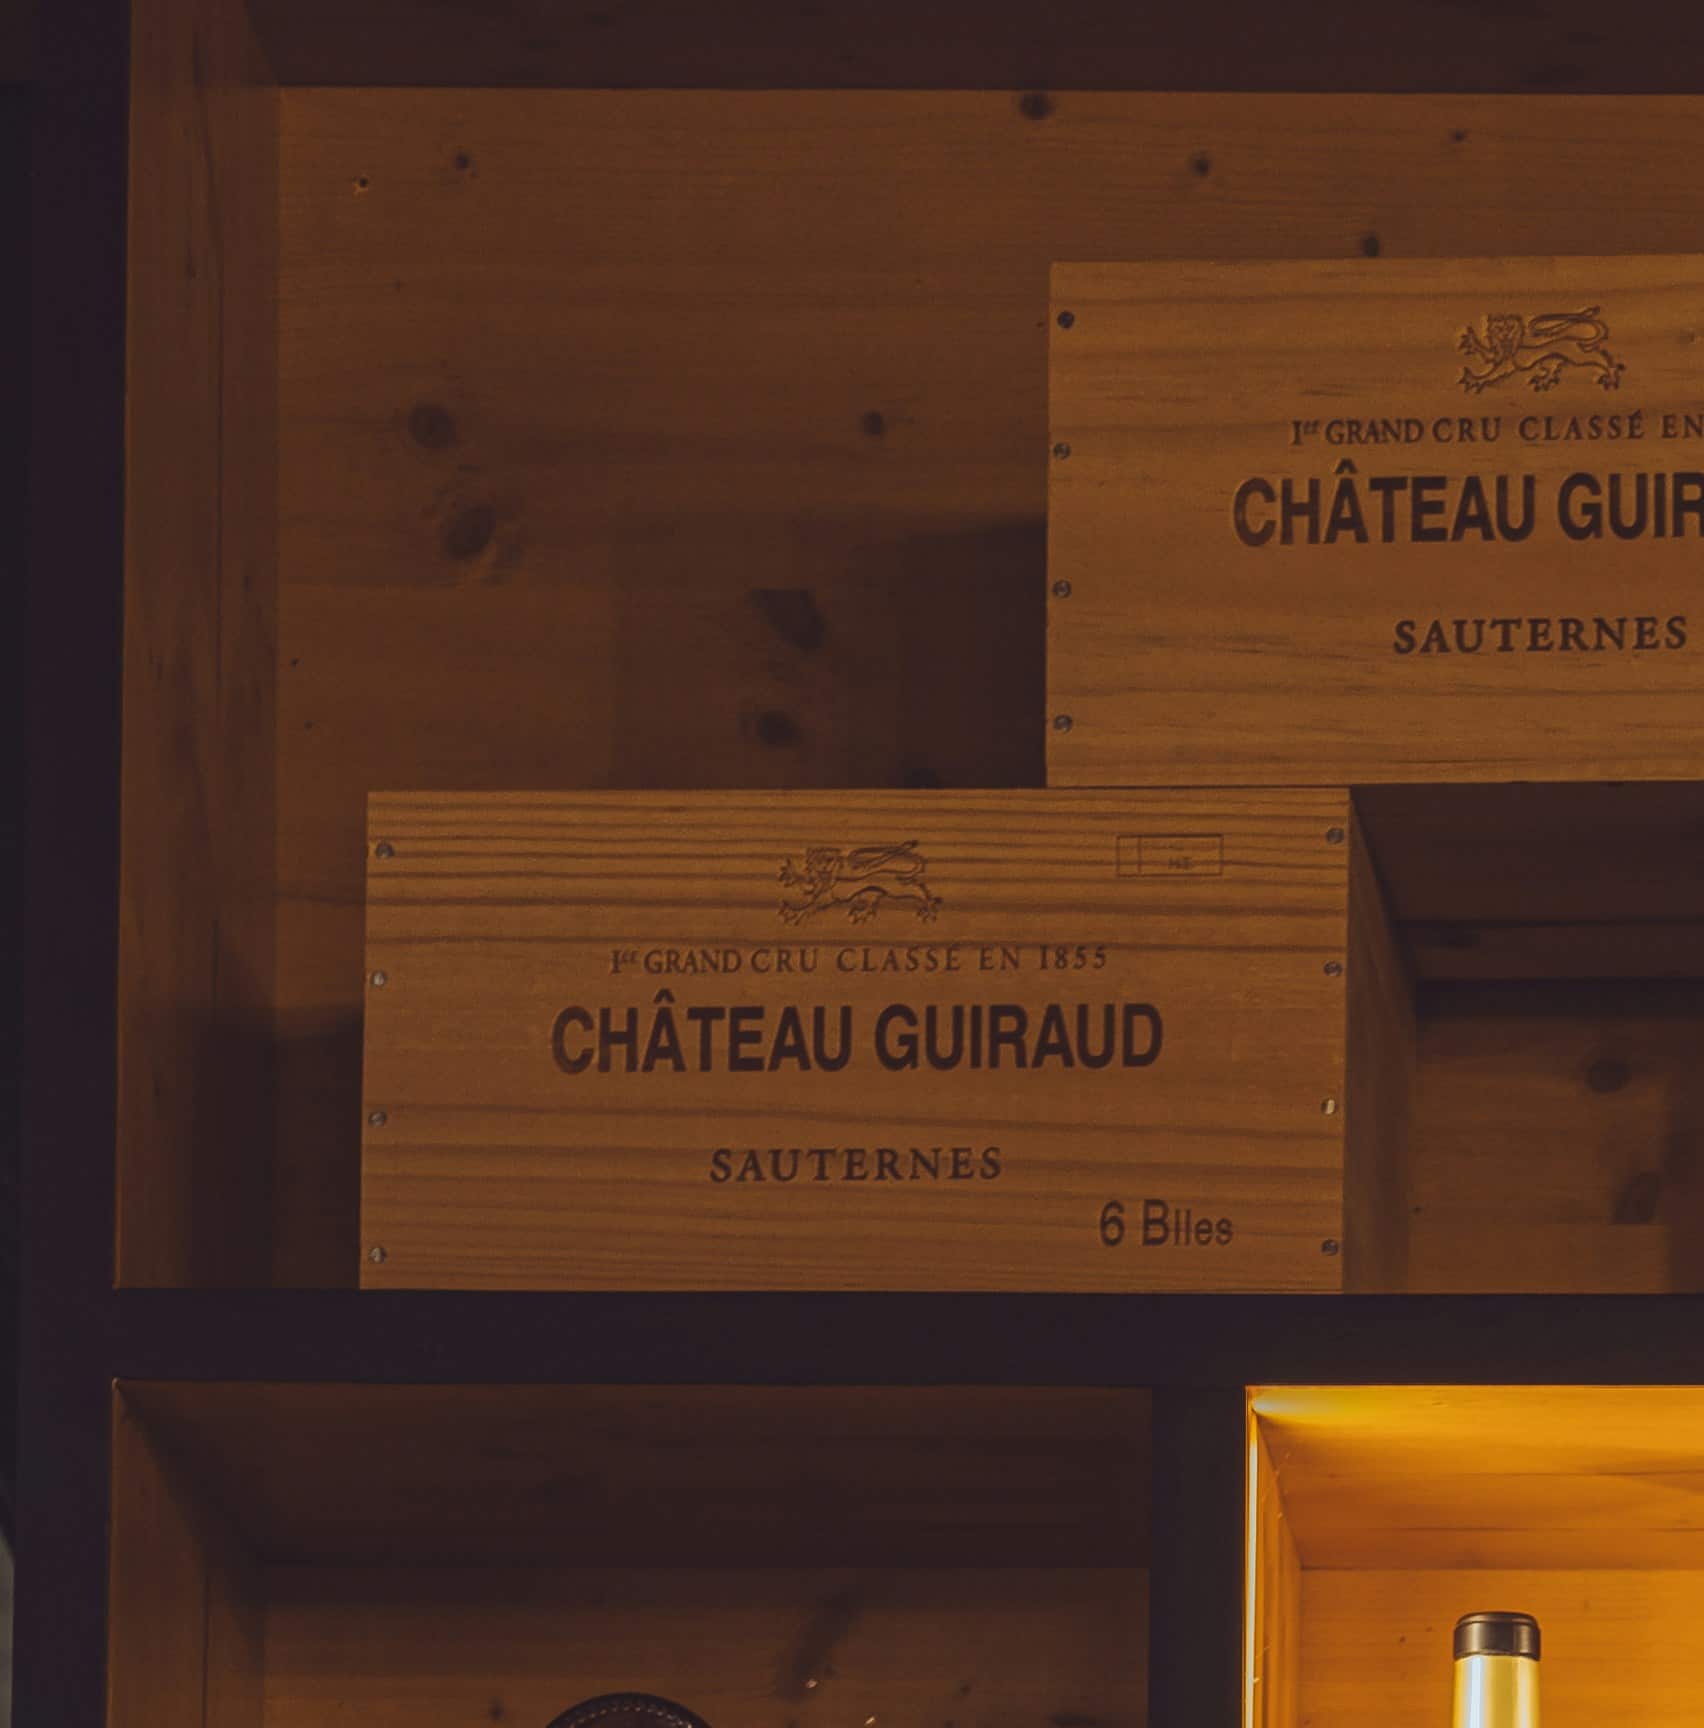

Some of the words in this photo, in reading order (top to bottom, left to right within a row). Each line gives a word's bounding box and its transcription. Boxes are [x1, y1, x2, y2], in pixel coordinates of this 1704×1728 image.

[1325, 418, 1424, 445] GRAND
[1432, 416, 1503, 443] CRU
[1518, 408, 1645, 441] CLASSÉ
[1661, 414, 1704, 439] EN
[1234, 458, 1536, 547] CHÂTEAU
[1393, 615, 1687, 655] SAUTERNES
[643, 948, 742, 974] GRAND
[751, 948, 818, 973] CRU
[835, 943, 961, 972] CLASSÉ
[978, 946, 1020, 971] EN
[1039, 945, 1107, 971] 1855
[552, 988, 852, 1074] CHÂTEAU
[875, 1002, 1163, 1072] GUIRAUD
[710, 1147, 1001, 1183] SAUTERNES
[1100, 1200, 1125, 1247] 6
